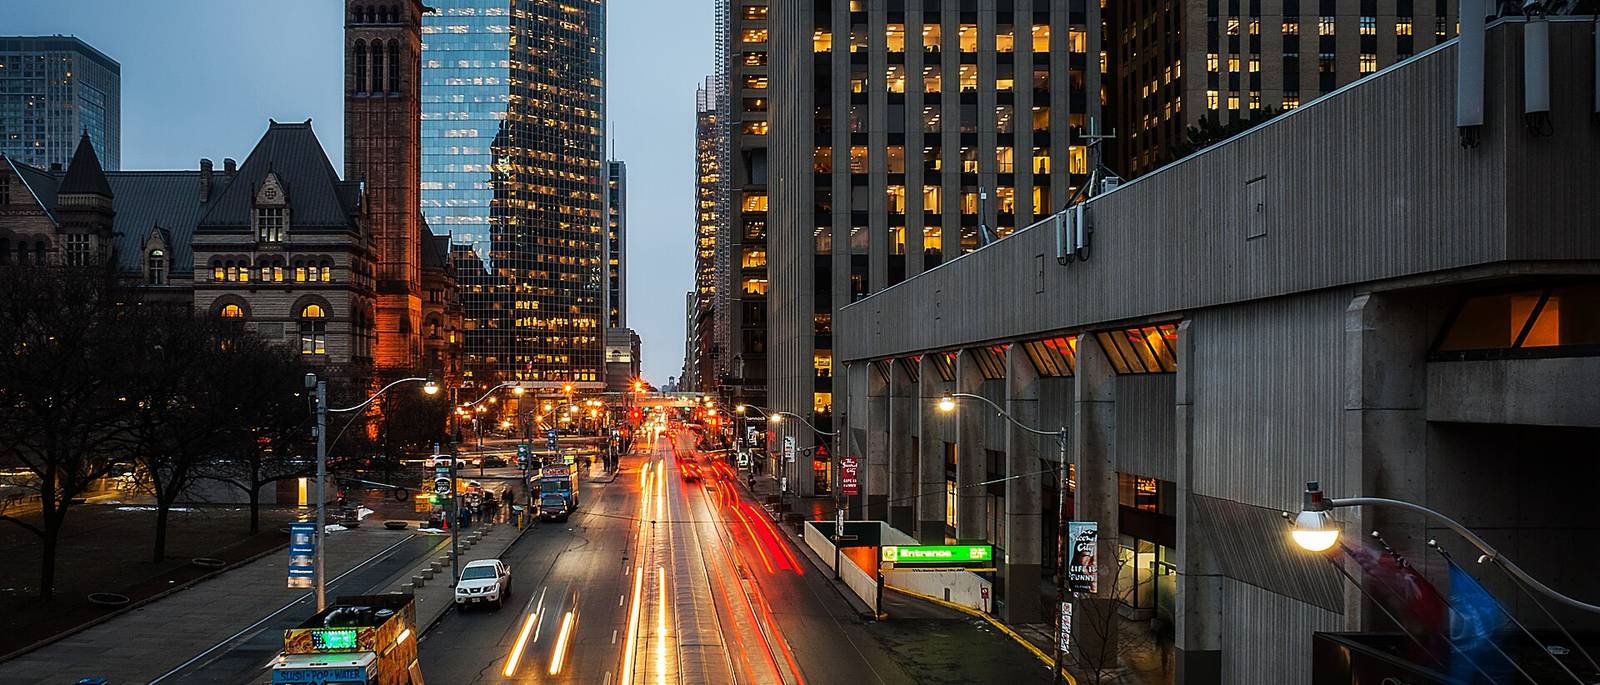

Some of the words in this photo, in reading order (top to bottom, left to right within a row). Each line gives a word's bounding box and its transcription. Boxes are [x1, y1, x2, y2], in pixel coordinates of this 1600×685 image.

[900, 548, 952, 558] Entrance
[1077, 542, 1095, 557] City
[1070, 565, 1086, 573] LIFE
[280, 669, 305, 681] SLUSH
[311, 669, 330, 681] POP
[335, 669, 360, 681] WATER
